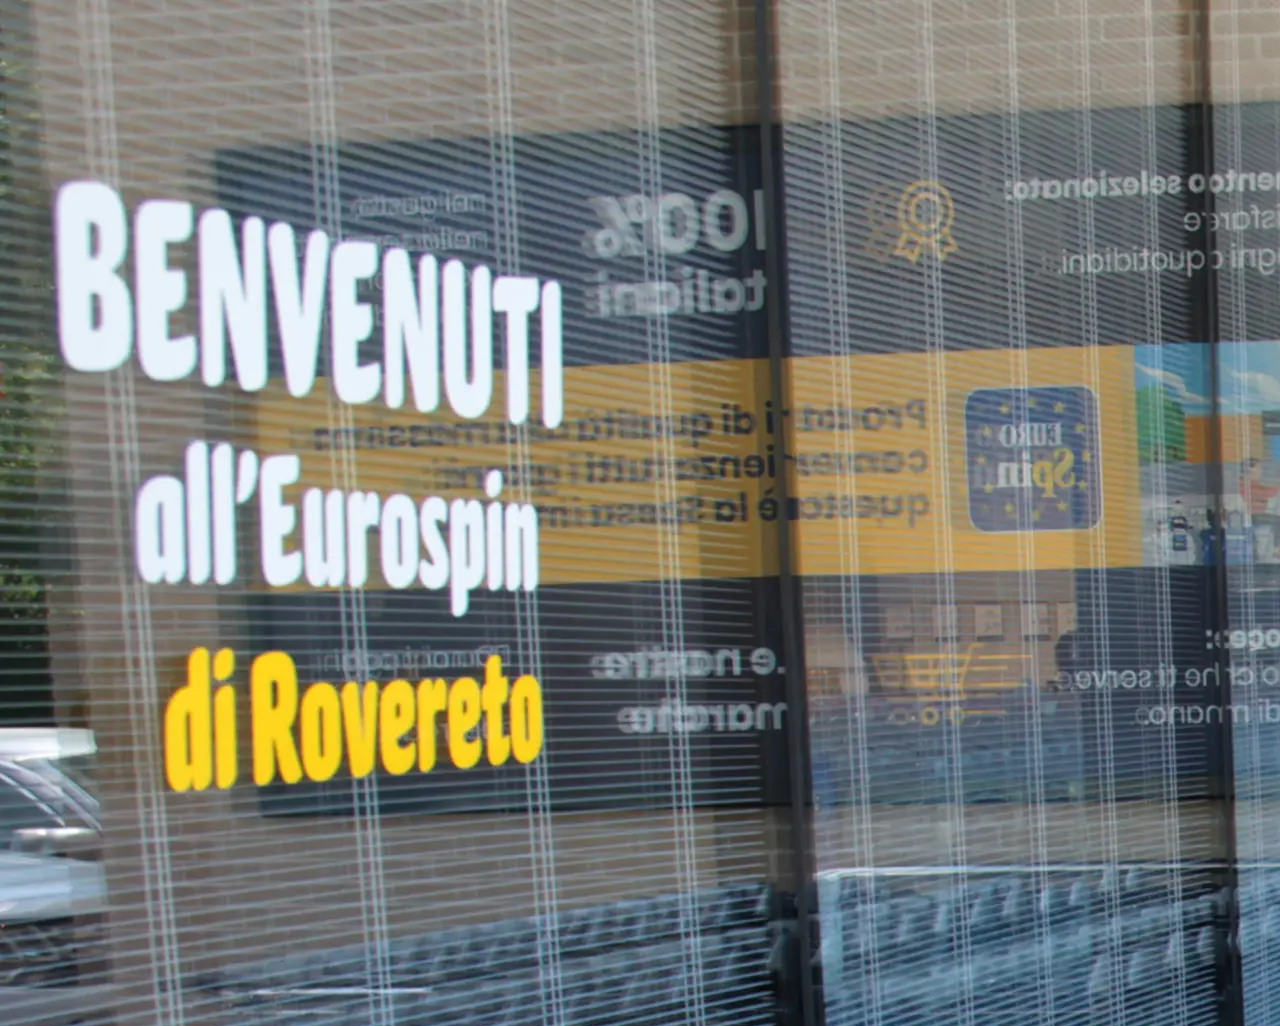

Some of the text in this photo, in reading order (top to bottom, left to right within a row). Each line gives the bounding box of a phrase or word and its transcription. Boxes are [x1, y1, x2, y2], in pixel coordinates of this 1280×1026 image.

[54, 180, 565, 429] BENVENUTI
[135, 440, 539, 617] all'Eurospin
[164, 646, 544, 792] di Rovereto
